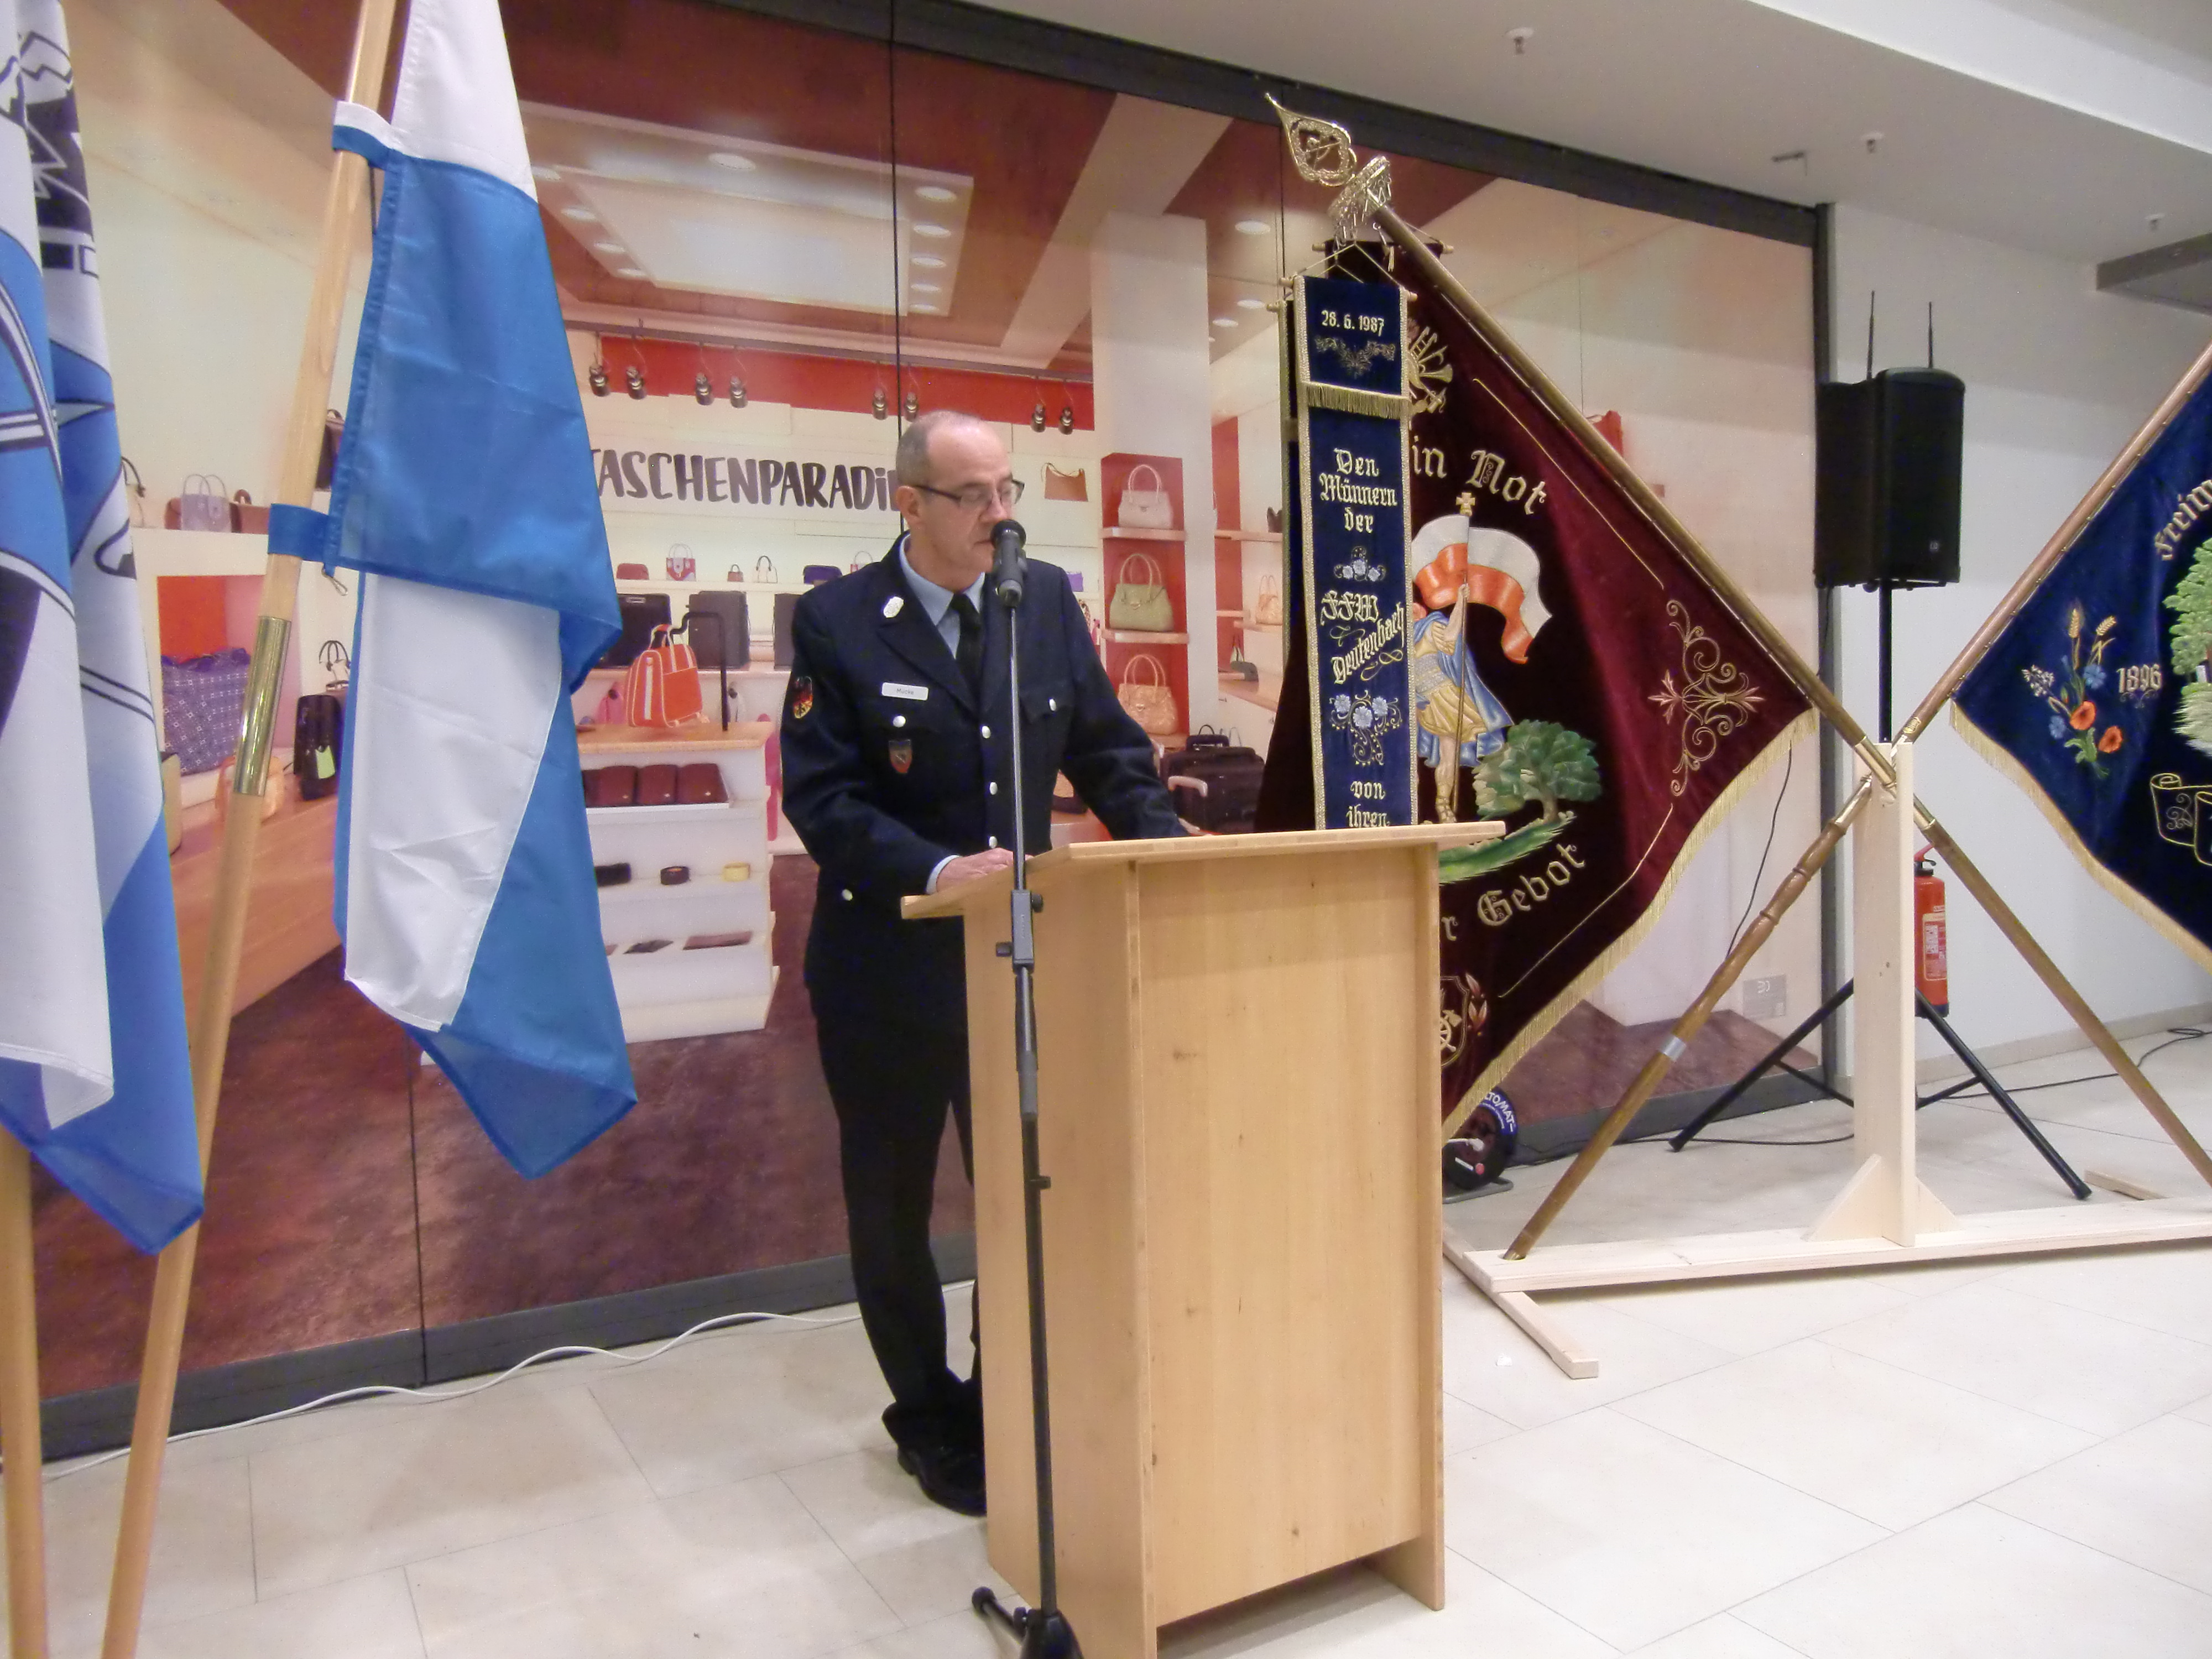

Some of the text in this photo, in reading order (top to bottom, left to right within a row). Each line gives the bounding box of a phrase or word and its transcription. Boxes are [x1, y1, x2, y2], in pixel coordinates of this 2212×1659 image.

[1321, 310, 1385, 337] 28. 6. 1987
[1333, 447, 1380, 477] Den
[1411, 435, 1547, 515] in Not
[1318, 472, 1398, 507] Männern
[1344, 507, 1374, 534] der
[2115, 664, 2162, 694] 1896
[1350, 780, 1386, 800] von
[1345, 803, 1391, 828] ihren
[1477, 843, 1585, 926] Gebot
